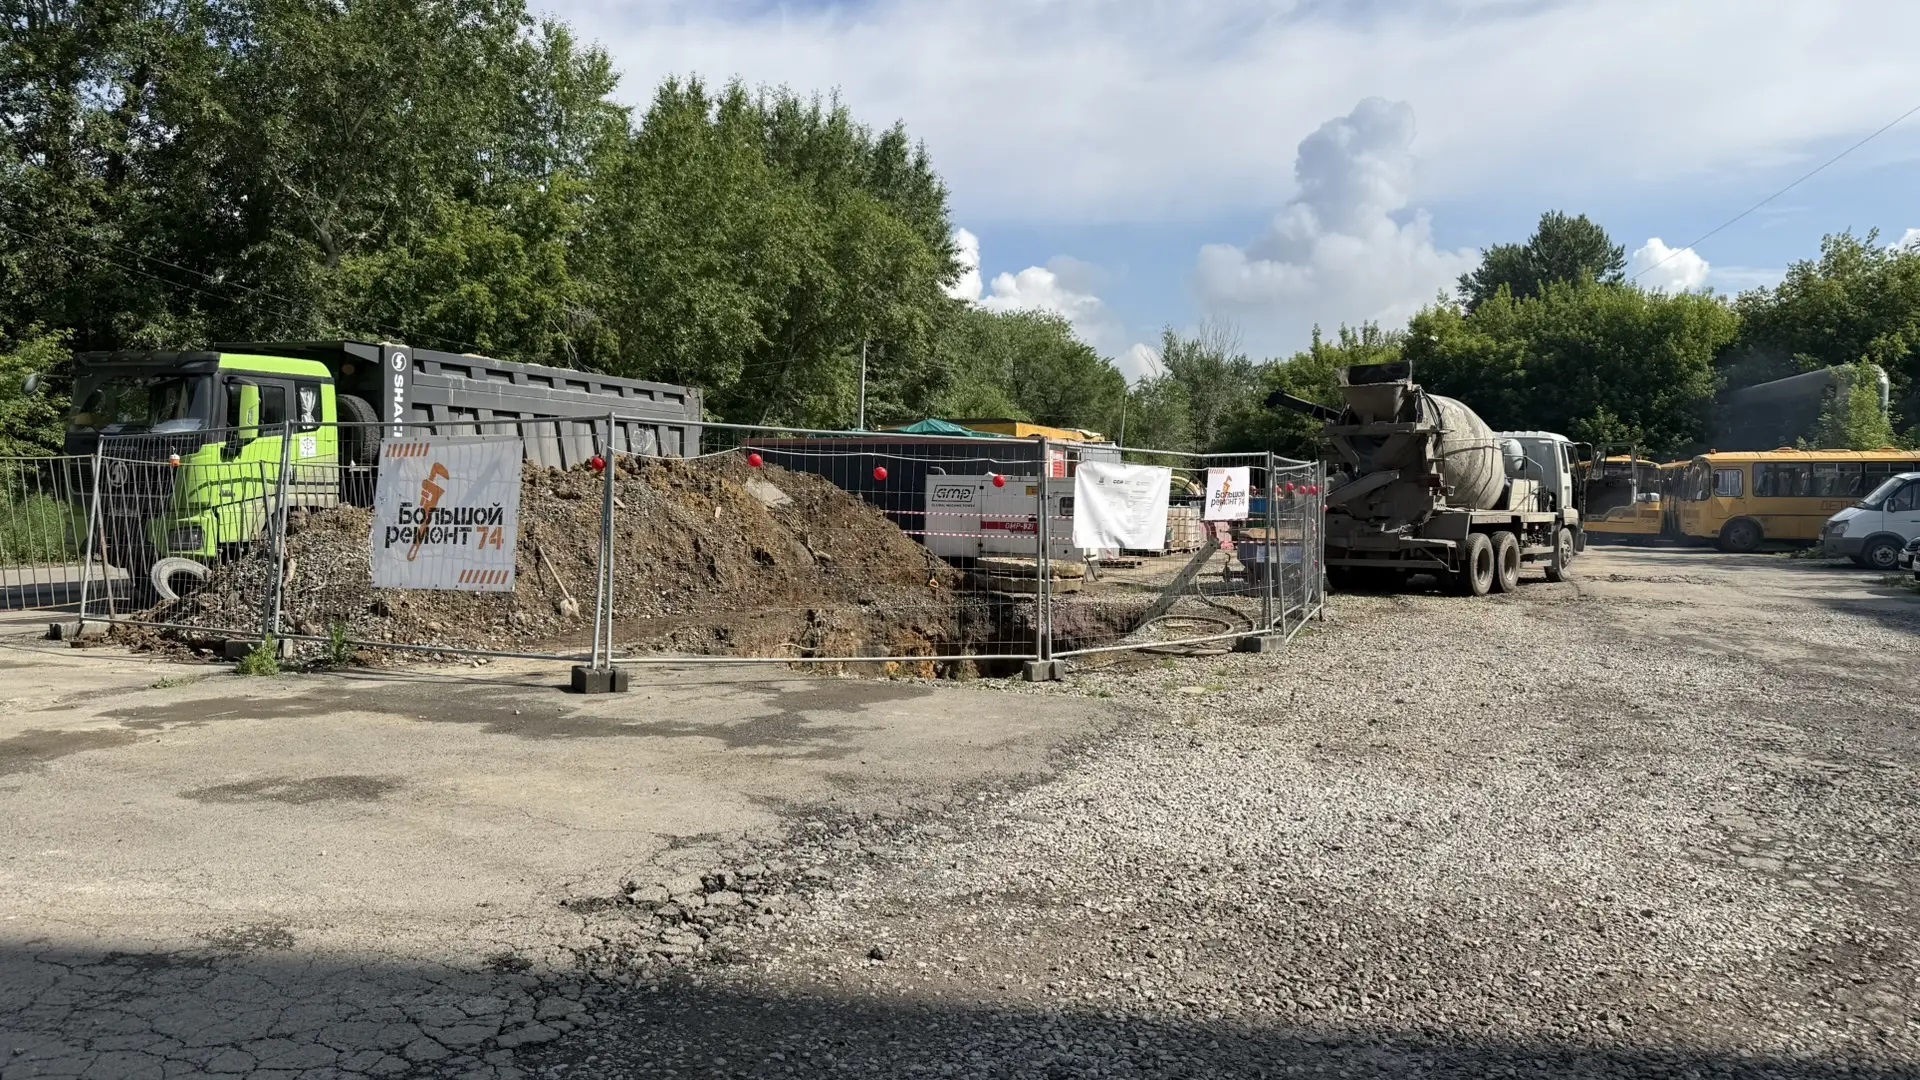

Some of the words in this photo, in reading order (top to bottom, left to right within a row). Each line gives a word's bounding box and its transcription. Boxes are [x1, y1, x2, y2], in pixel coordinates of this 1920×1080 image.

[398, 502, 504, 525] Большой
[384, 526, 472, 548] ремонт
[476, 526, 504, 550] 74
